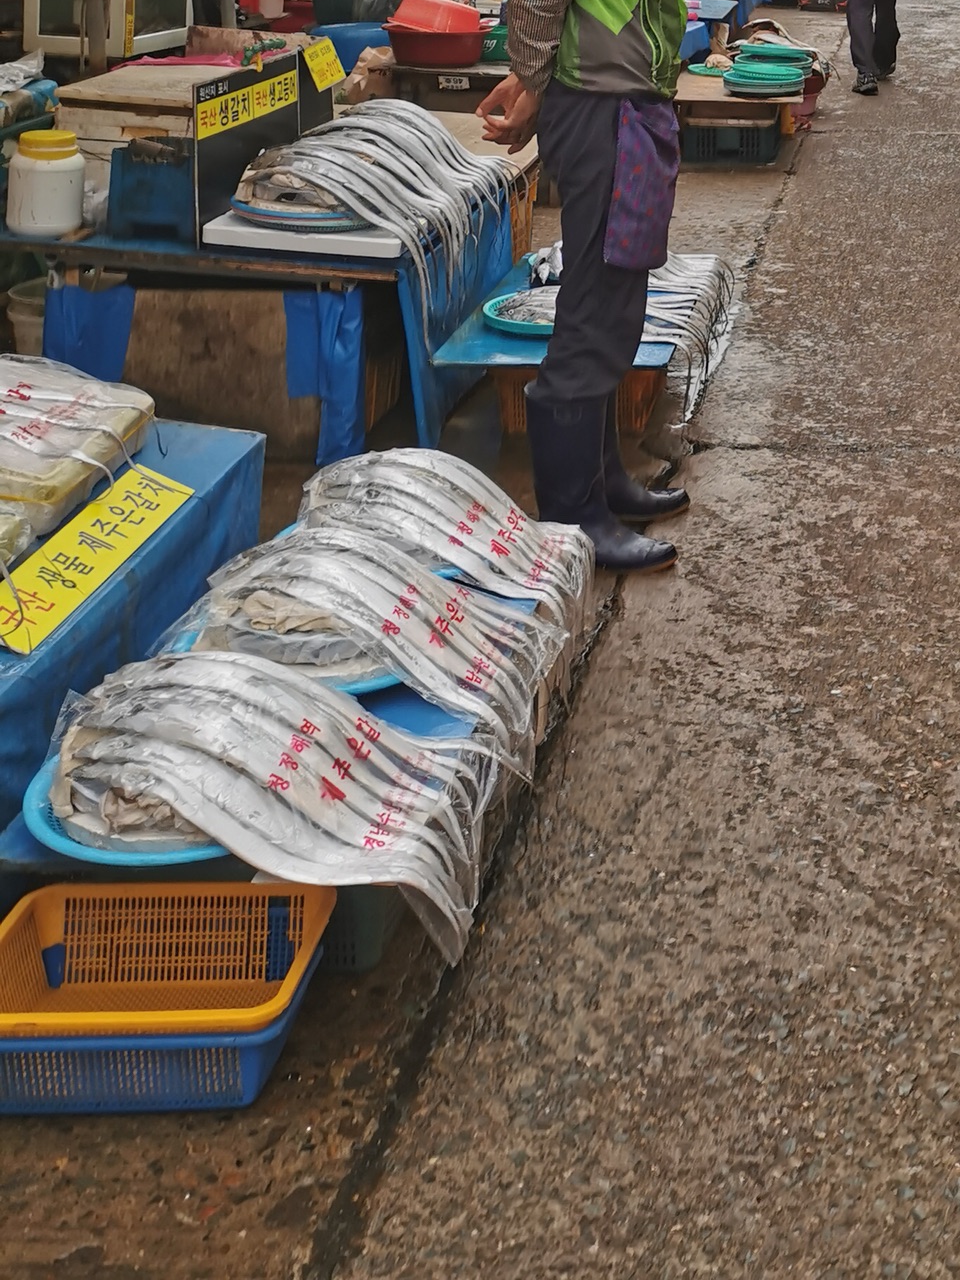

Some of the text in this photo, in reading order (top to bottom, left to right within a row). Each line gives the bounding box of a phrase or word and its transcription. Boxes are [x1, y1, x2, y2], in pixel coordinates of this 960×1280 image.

[201, 91, 251, 128] 국산 생갈치
[255, 91, 268, 109] 국산
[269, 73, 296, 107] 생고등어
[36, 551, 94, 590] 생물
[78, 475, 176, 556] 제주은갈치
